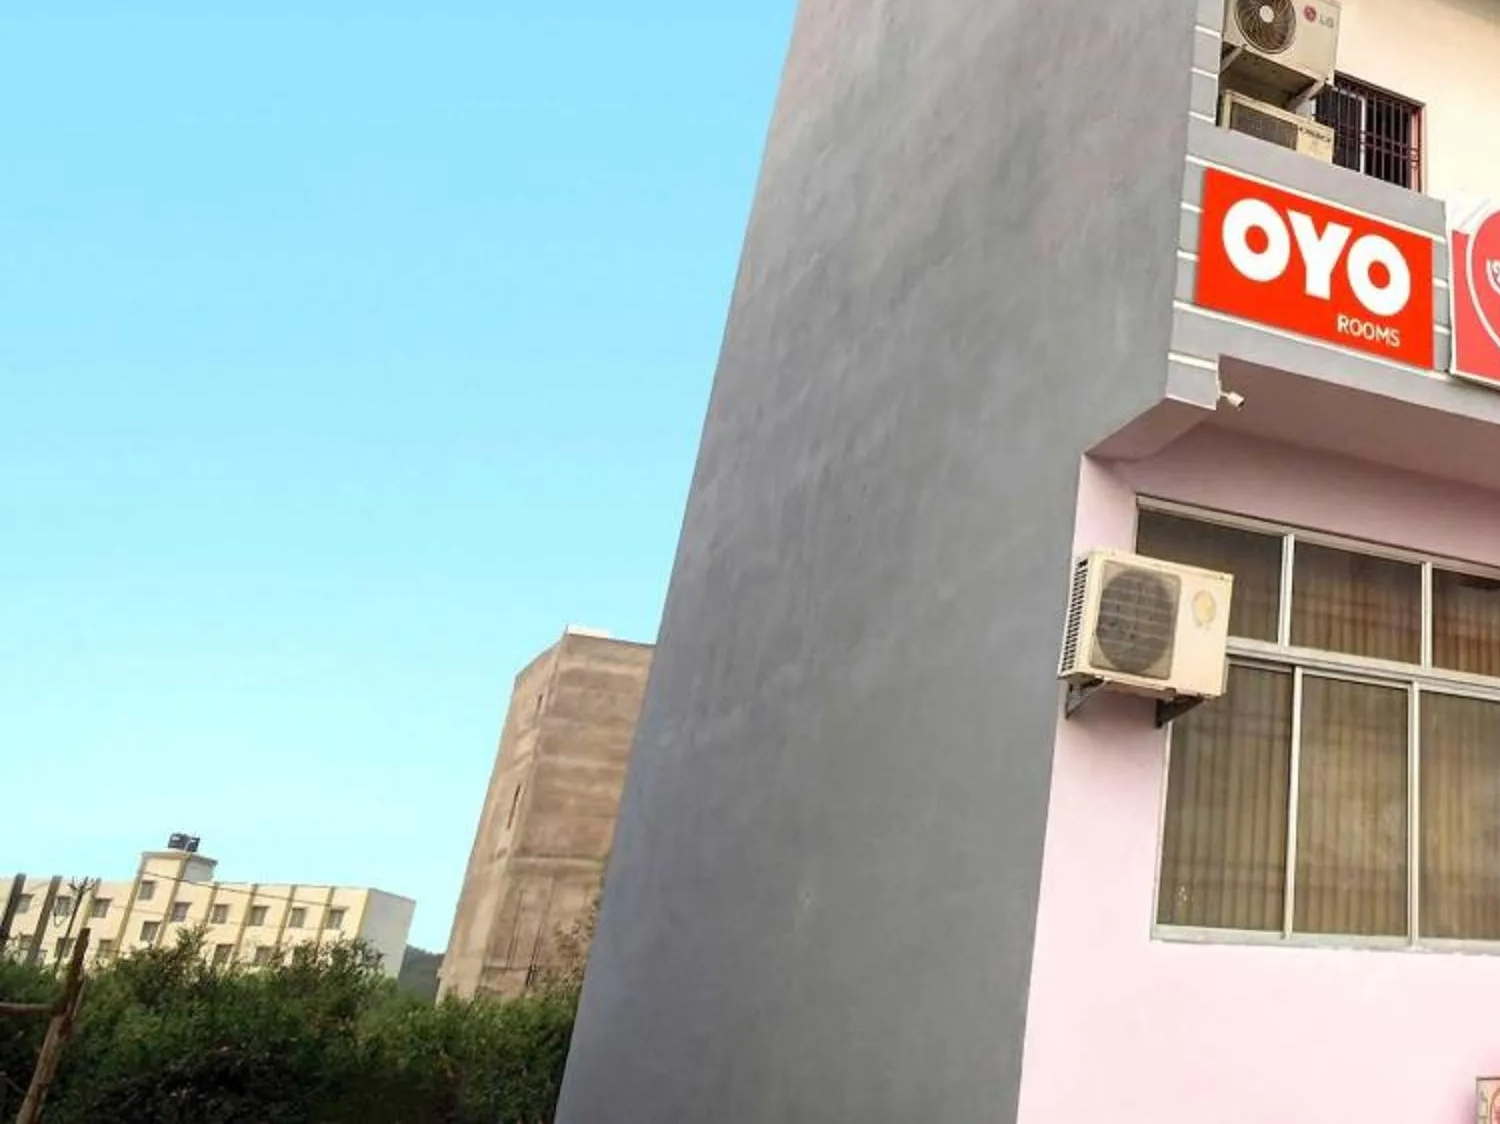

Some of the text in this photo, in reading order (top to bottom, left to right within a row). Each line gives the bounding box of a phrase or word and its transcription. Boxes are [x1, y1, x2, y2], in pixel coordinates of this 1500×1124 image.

[1319, 13, 1335, 29] LG
[1222, 197, 1412, 317] OYO
[1336, 313, 1401, 348] ROOMS
